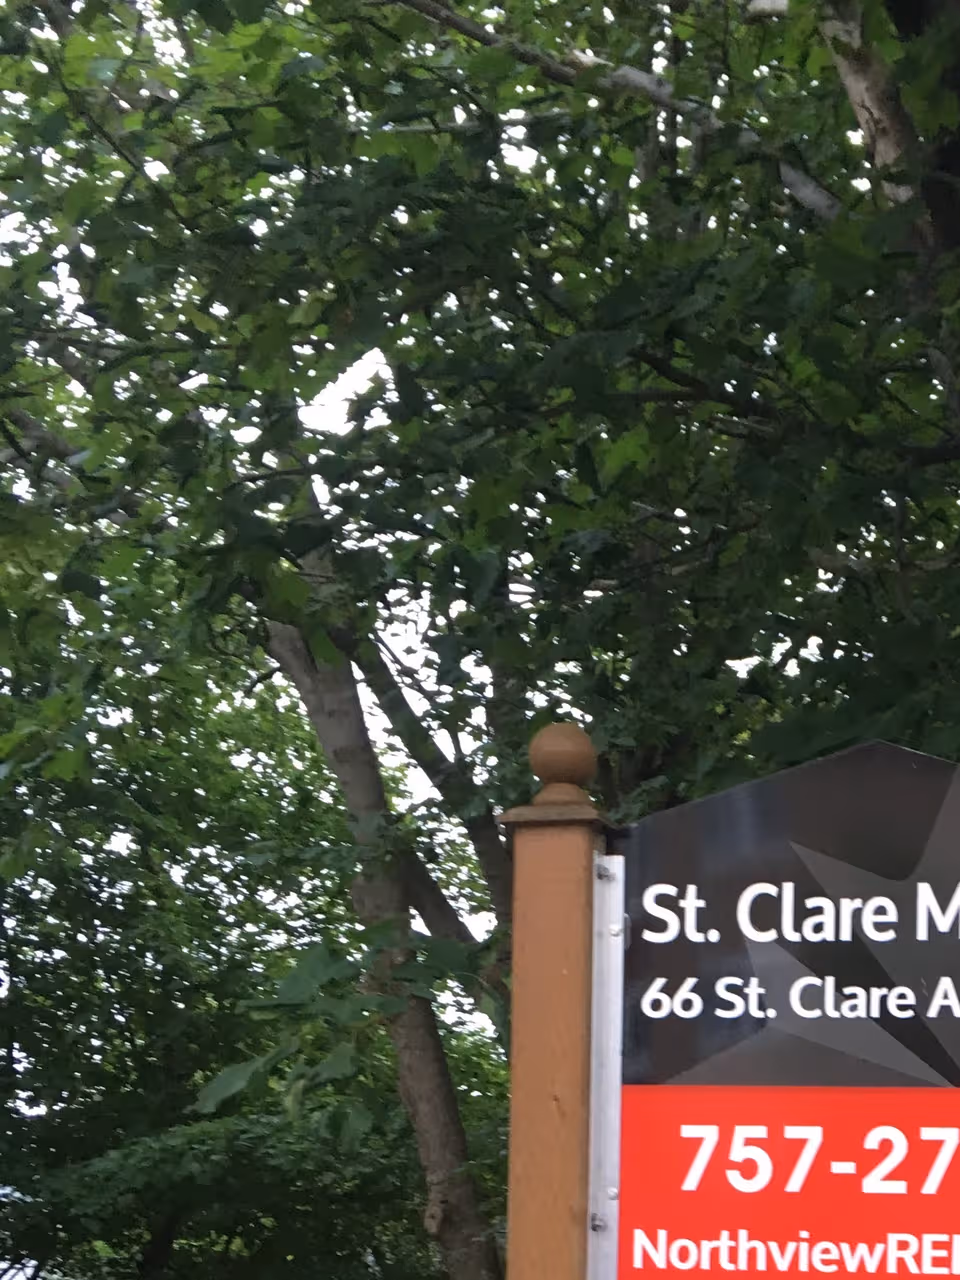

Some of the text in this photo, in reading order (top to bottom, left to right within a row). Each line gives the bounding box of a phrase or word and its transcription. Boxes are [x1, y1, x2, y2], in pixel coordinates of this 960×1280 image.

[641, 883, 721, 944] St.
[736, 882, 899, 943] Clare
[640, 977, 704, 1019] 66
[713, 976, 778, 1019] St.
[788, 975, 917, 1019] Clare
